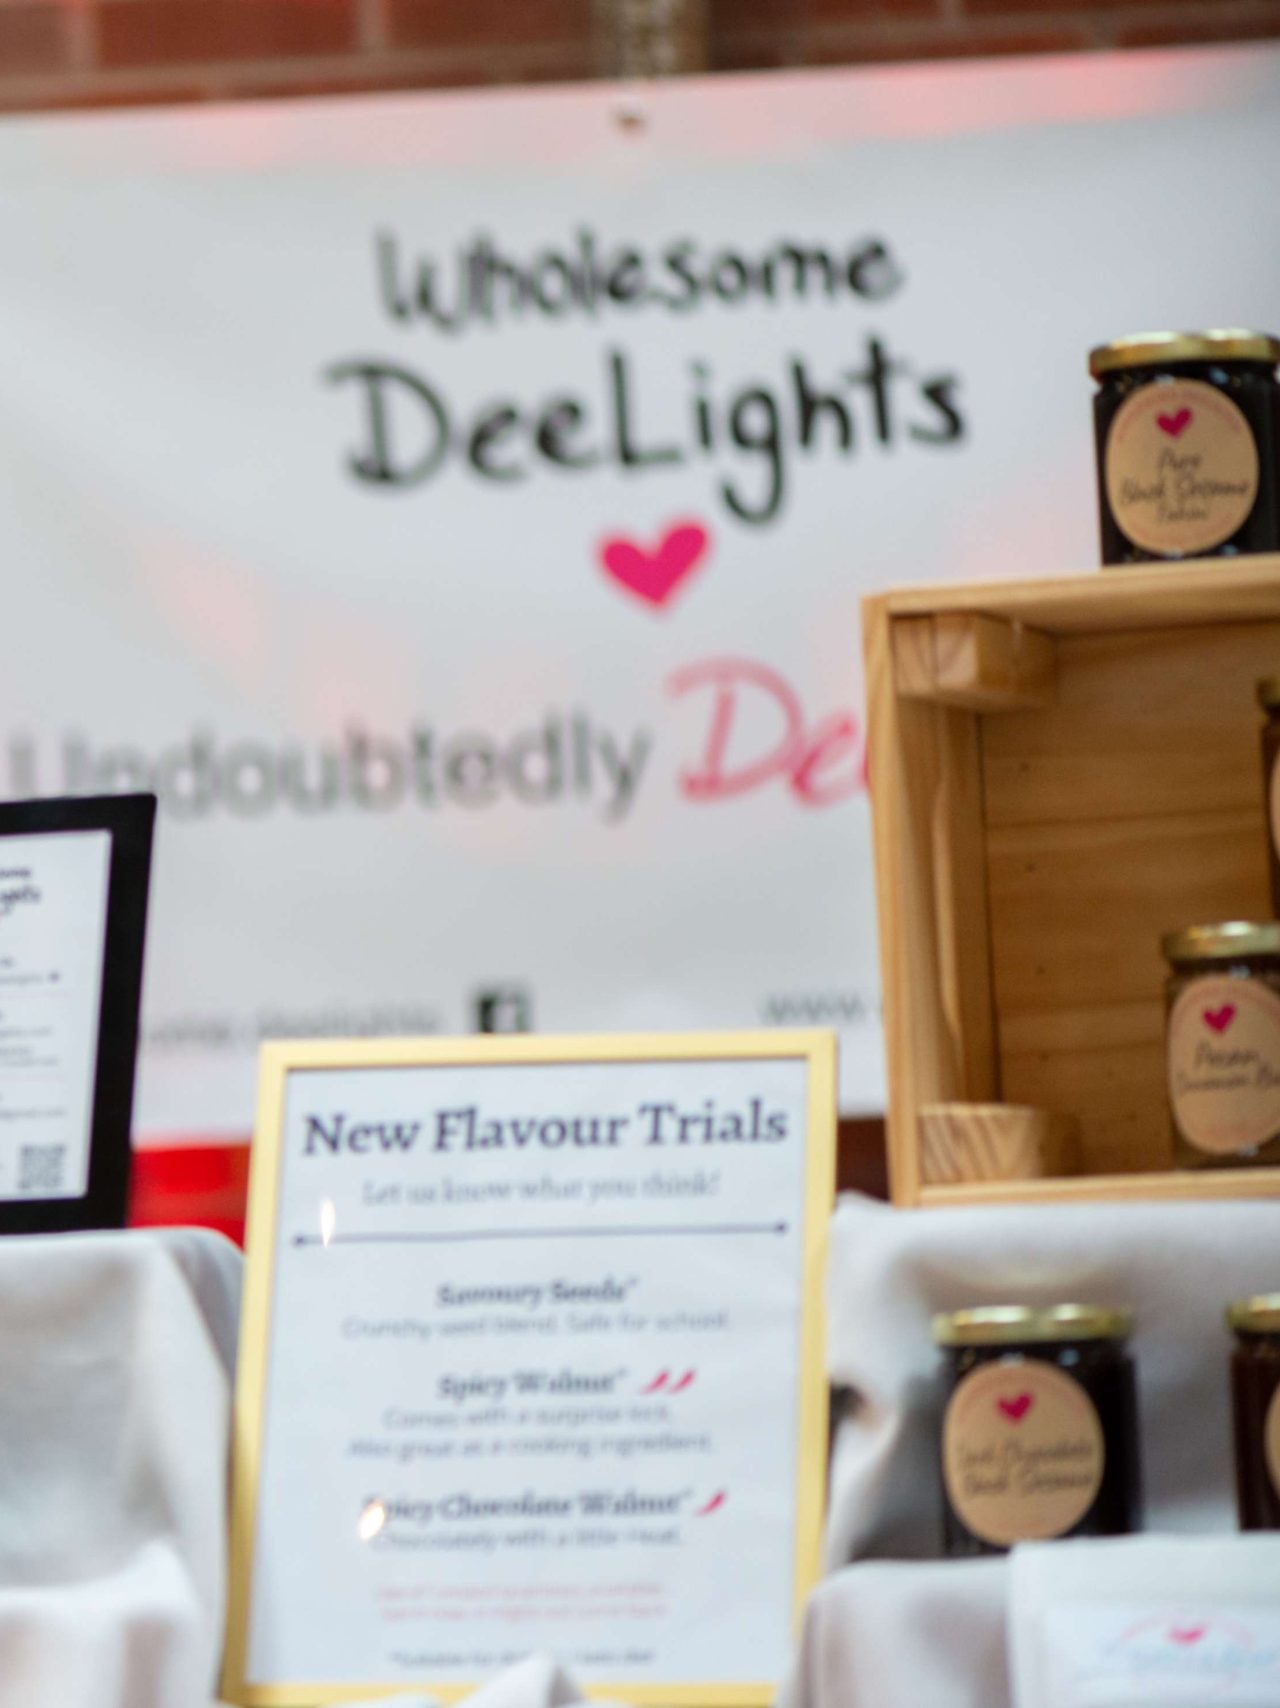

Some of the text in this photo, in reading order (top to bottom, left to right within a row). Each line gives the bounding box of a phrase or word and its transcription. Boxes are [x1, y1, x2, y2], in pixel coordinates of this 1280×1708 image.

[375, 225, 905, 333] Wholesome
[322, 332, 965, 525] DeeLights
[8, 654, 867, 828] Undoubtedly De
[302, 1096, 789, 1157] New Flavour Trials
